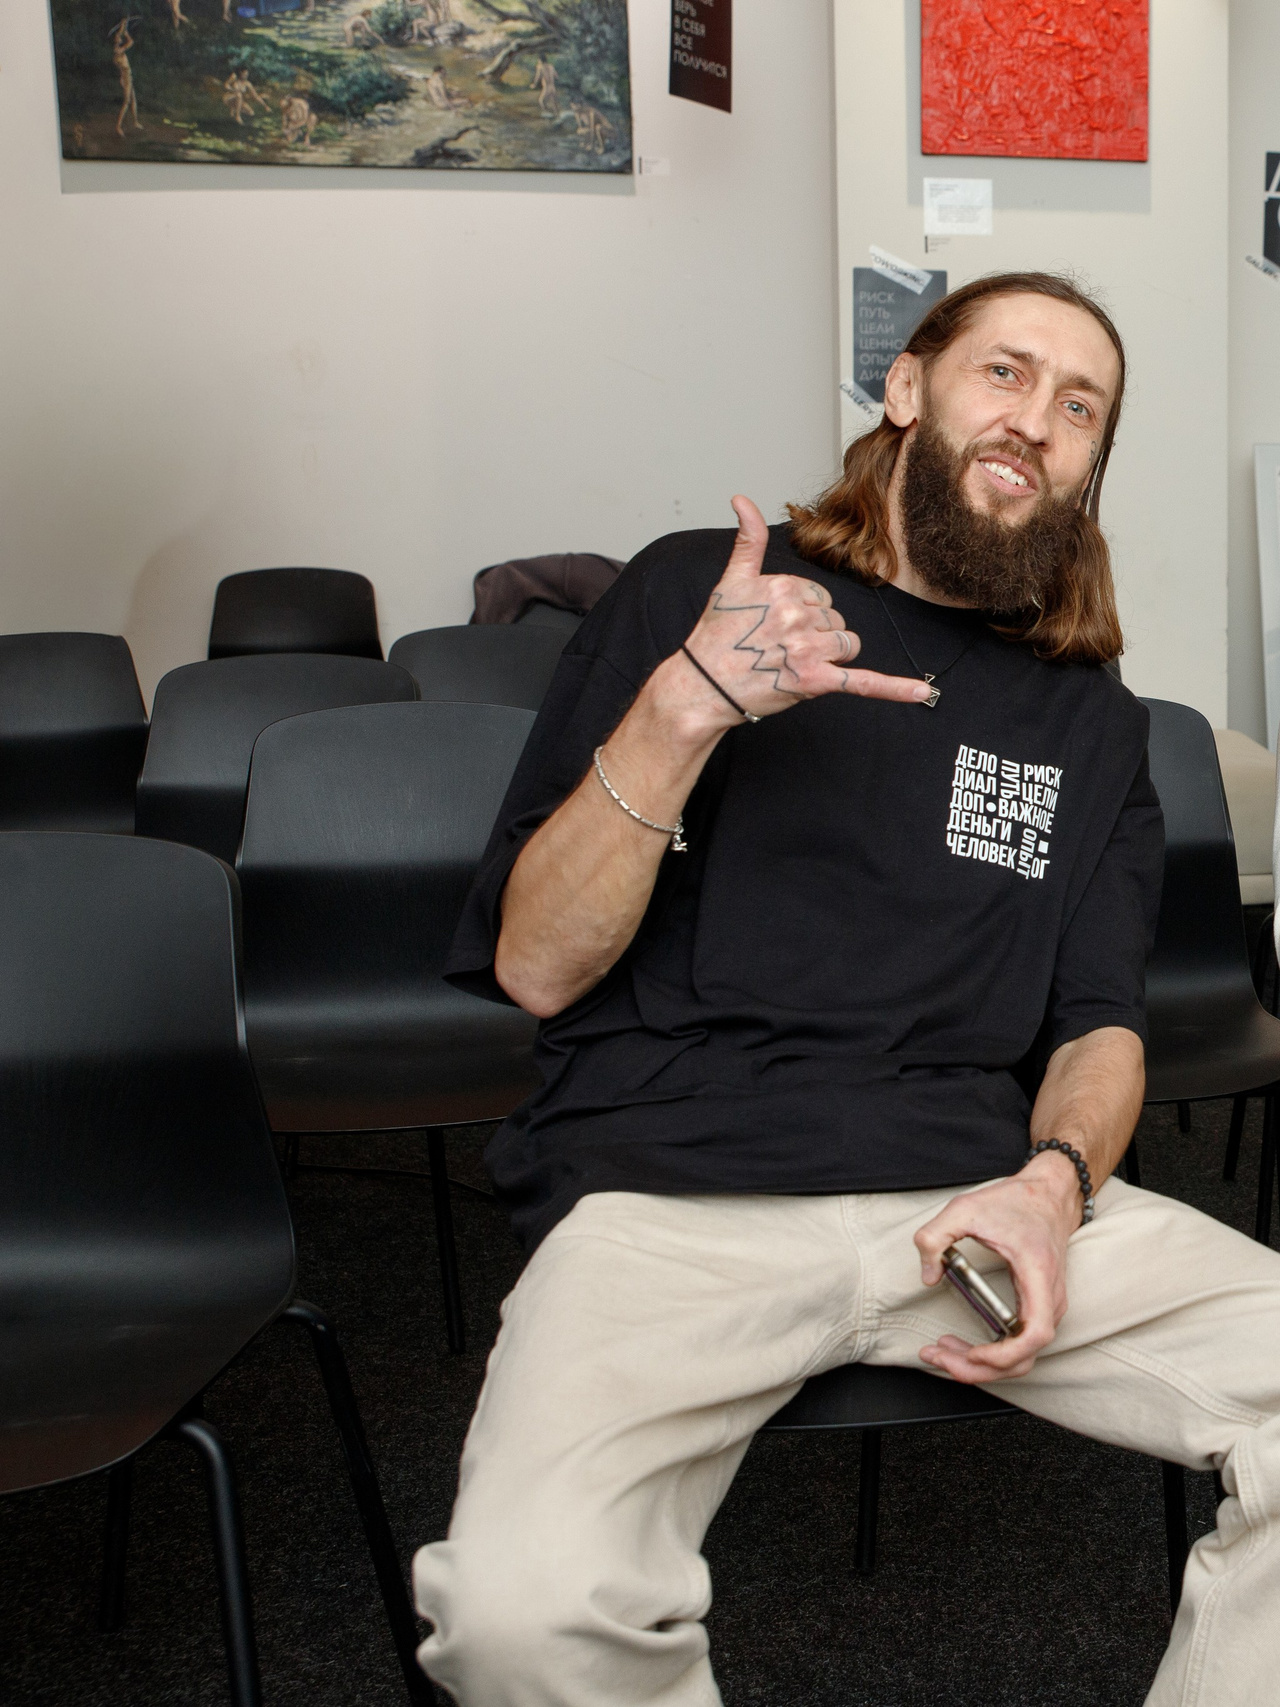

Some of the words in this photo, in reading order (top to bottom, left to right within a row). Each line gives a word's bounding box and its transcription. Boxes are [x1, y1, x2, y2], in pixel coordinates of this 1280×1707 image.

[859, 290, 895, 304] РИСК
[859, 306, 892, 320] ПУТЬ
[859, 321, 895, 335] ЦЕЛИ
[955, 744, 998, 775] ДЕЛО
[952, 766, 997, 796] ДИАЛ
[1000, 759, 1021, 800] ПУТЬ
[1023, 763, 1063, 790] РИСК
[949, 787, 985, 814] ДОП
[1021, 782, 1059, 812] ЦЕЛИ
[946, 809, 1013, 843] ДЕНЬГИ
[998, 798, 1055, 835] ВАЖНОЕ
[946, 832, 1018, 870] ЧЕЛОВЕК
[1016, 828, 1038, 880] ОПЫТ
[1030, 857, 1051, 880] ОГ
